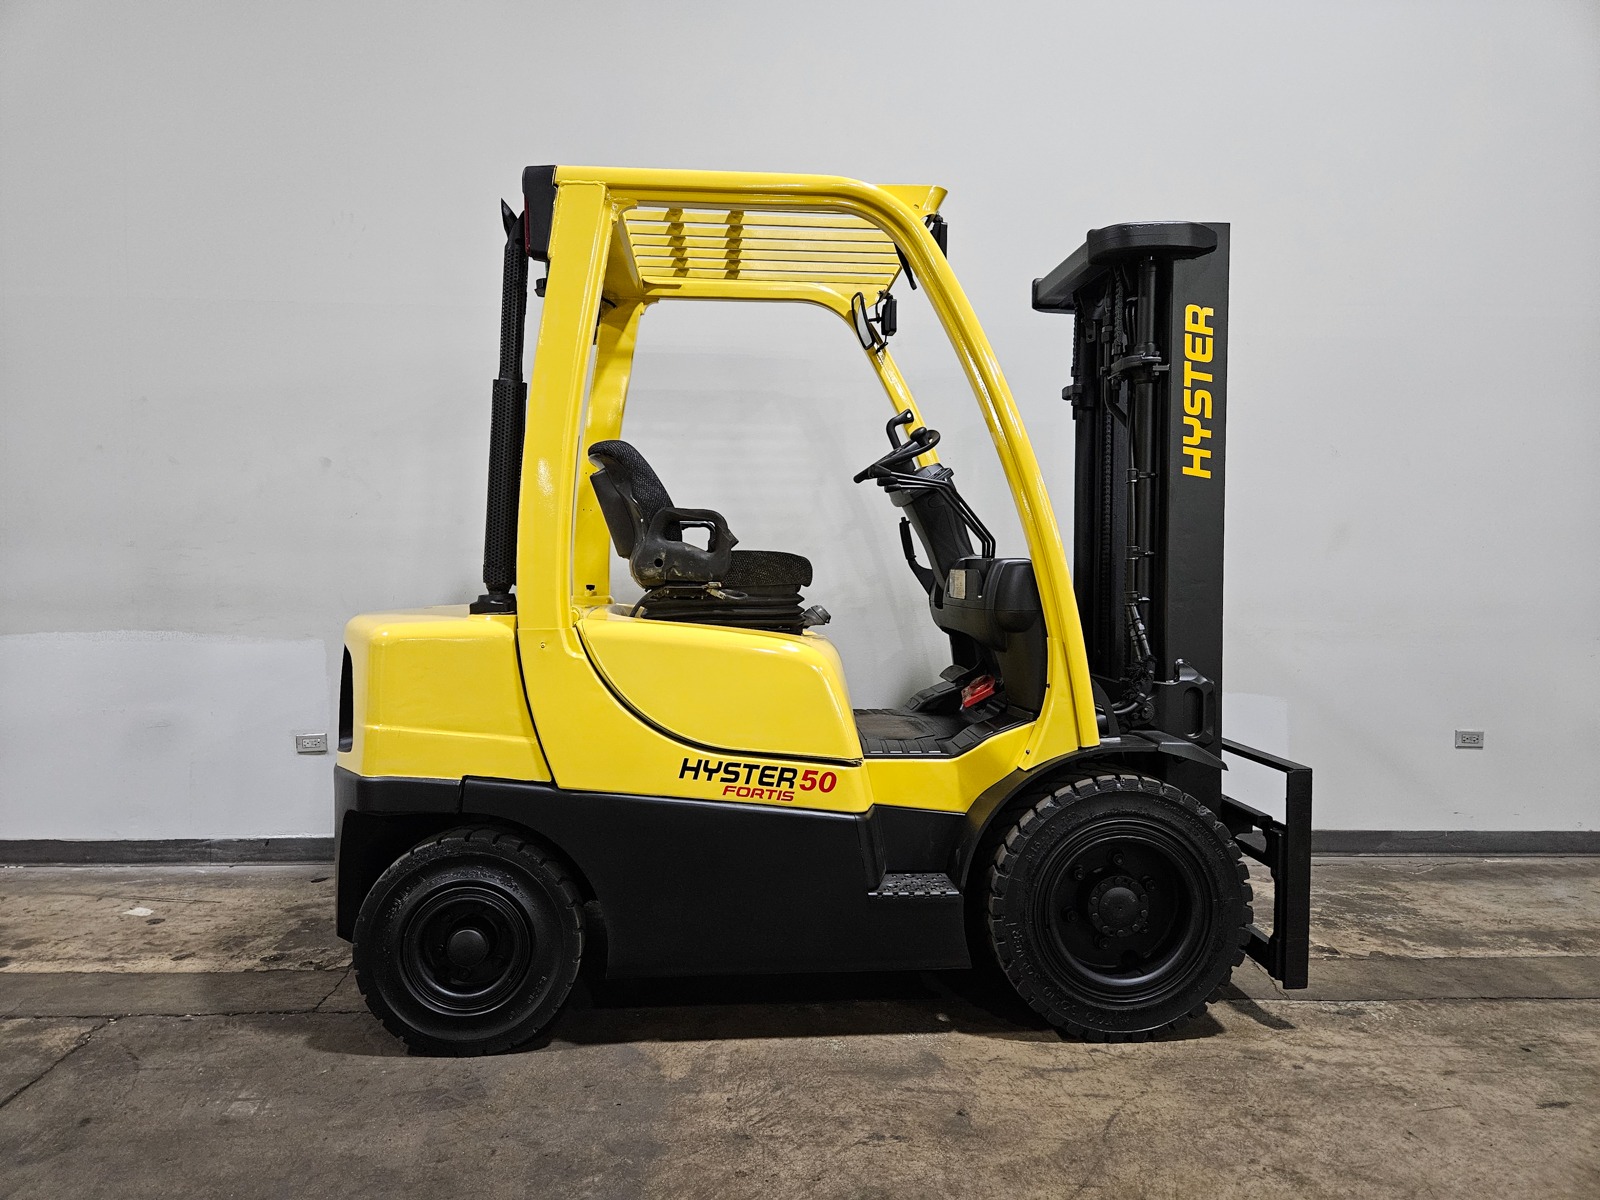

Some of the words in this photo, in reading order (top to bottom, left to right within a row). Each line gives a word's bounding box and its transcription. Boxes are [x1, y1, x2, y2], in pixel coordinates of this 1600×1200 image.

[1182, 303, 1214, 479] HYSTER
[678, 758, 798, 789] HYSTER
[799, 769, 838, 793] 50
[722, 785, 795, 801] FORTIS
